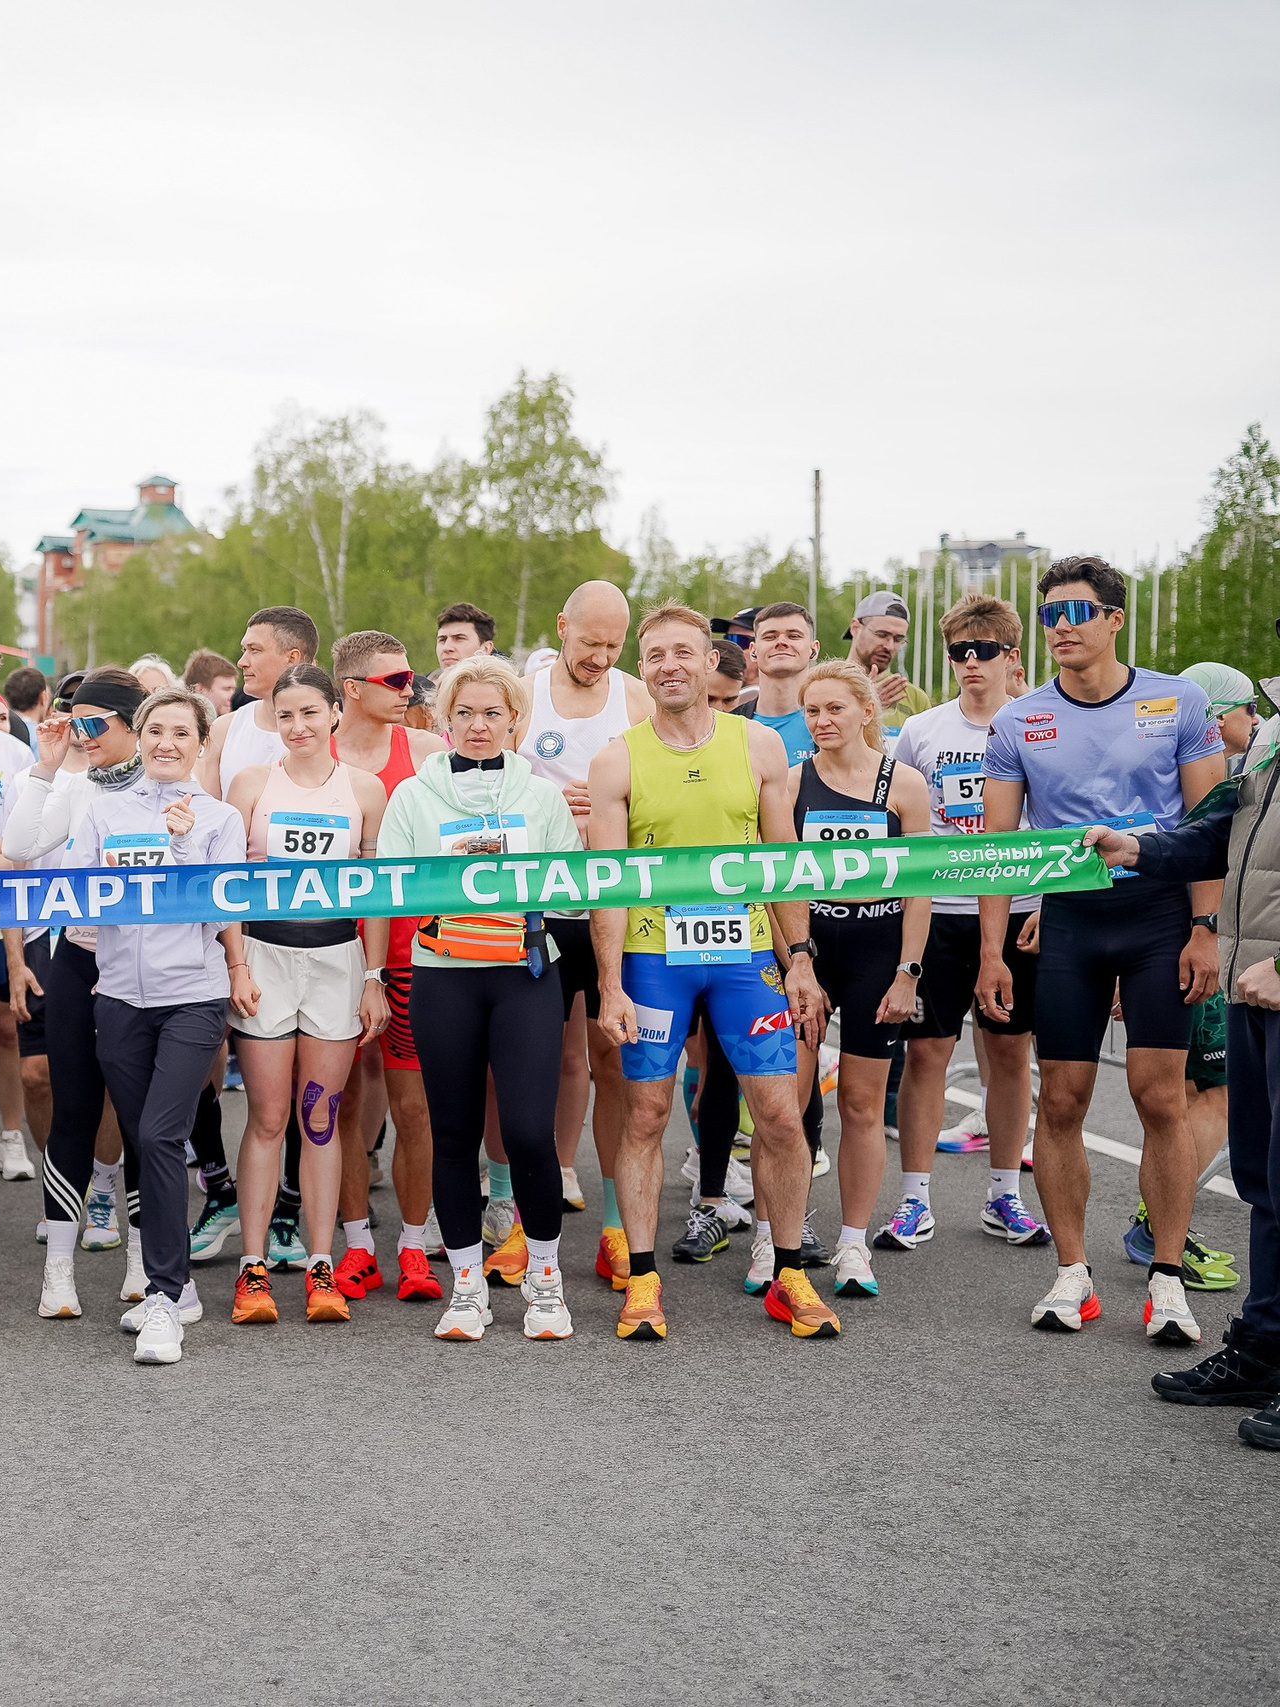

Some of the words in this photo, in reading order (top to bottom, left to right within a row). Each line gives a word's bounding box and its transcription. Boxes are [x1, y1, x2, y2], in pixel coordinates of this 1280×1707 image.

[1148, 718, 1174, 726] ЮГОРИЯ
[875, 780, 888, 805] PRO
[284, 829, 335, 855] 587
[948, 840, 1044, 863] зелёный
[211, 864, 416, 913] СТАРТ
[461, 855, 663, 905] СТАРТ
[709, 846, 910, 896] СТАРТ
[932, 861, 1031, 883] марафон
[809, 900, 850, 919] PRO
[857, 900, 901, 919] NIKE
[675, 920, 743, 945] 1055
